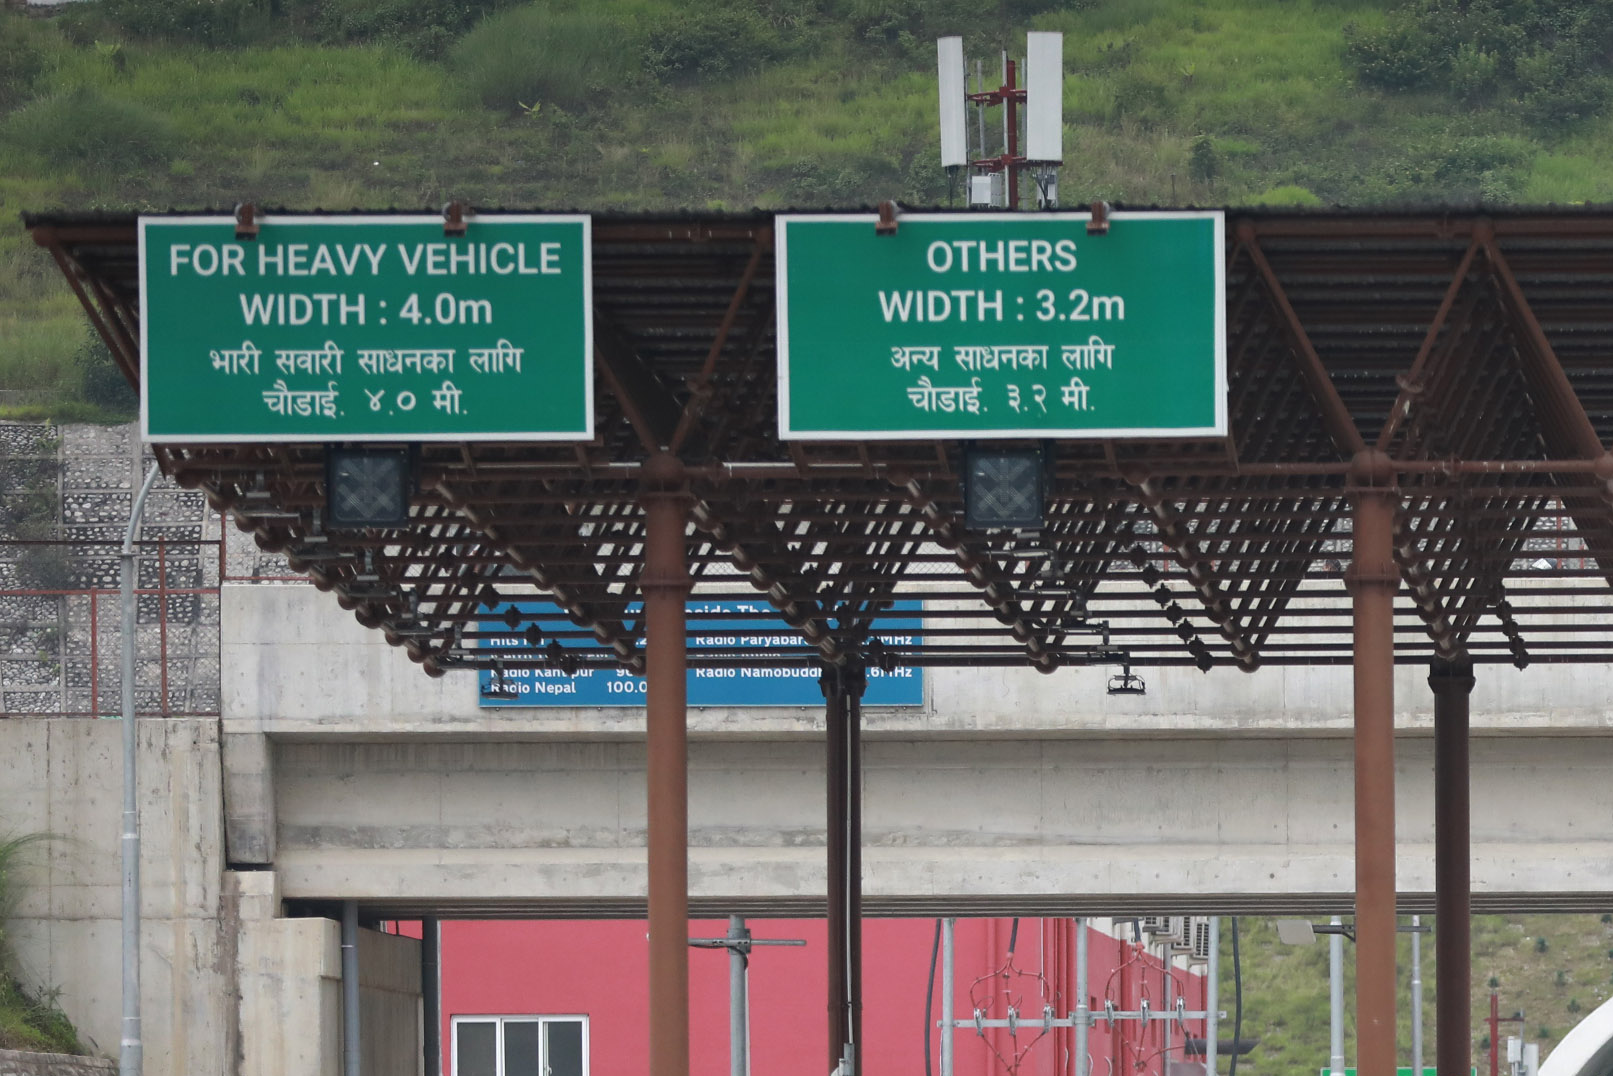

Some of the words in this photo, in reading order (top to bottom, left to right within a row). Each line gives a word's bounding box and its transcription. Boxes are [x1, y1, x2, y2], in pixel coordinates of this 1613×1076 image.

[170, 243, 246, 276] FOR
[258, 243, 387, 276] HEAVY
[397, 242, 561, 275] VEHICLE
[927, 239, 1077, 273] OTHERS
[239, 293, 366, 326] WIDTH
[399, 292, 492, 325] 4.0m
[878, 289, 1003, 323] WIDTH
[1036, 288, 1125, 321] 3.2m
[209, 340, 262, 375] भारी
[274, 340, 345, 375] सवारी
[357, 348, 456, 375] साधनका
[468, 338, 525, 374] लागि
[890, 345, 942, 371] अन्य
[953, 345, 1049, 371] साधनका
[1061, 335, 1116, 370] लागि
[535, 681, 576, 695] Nepal
